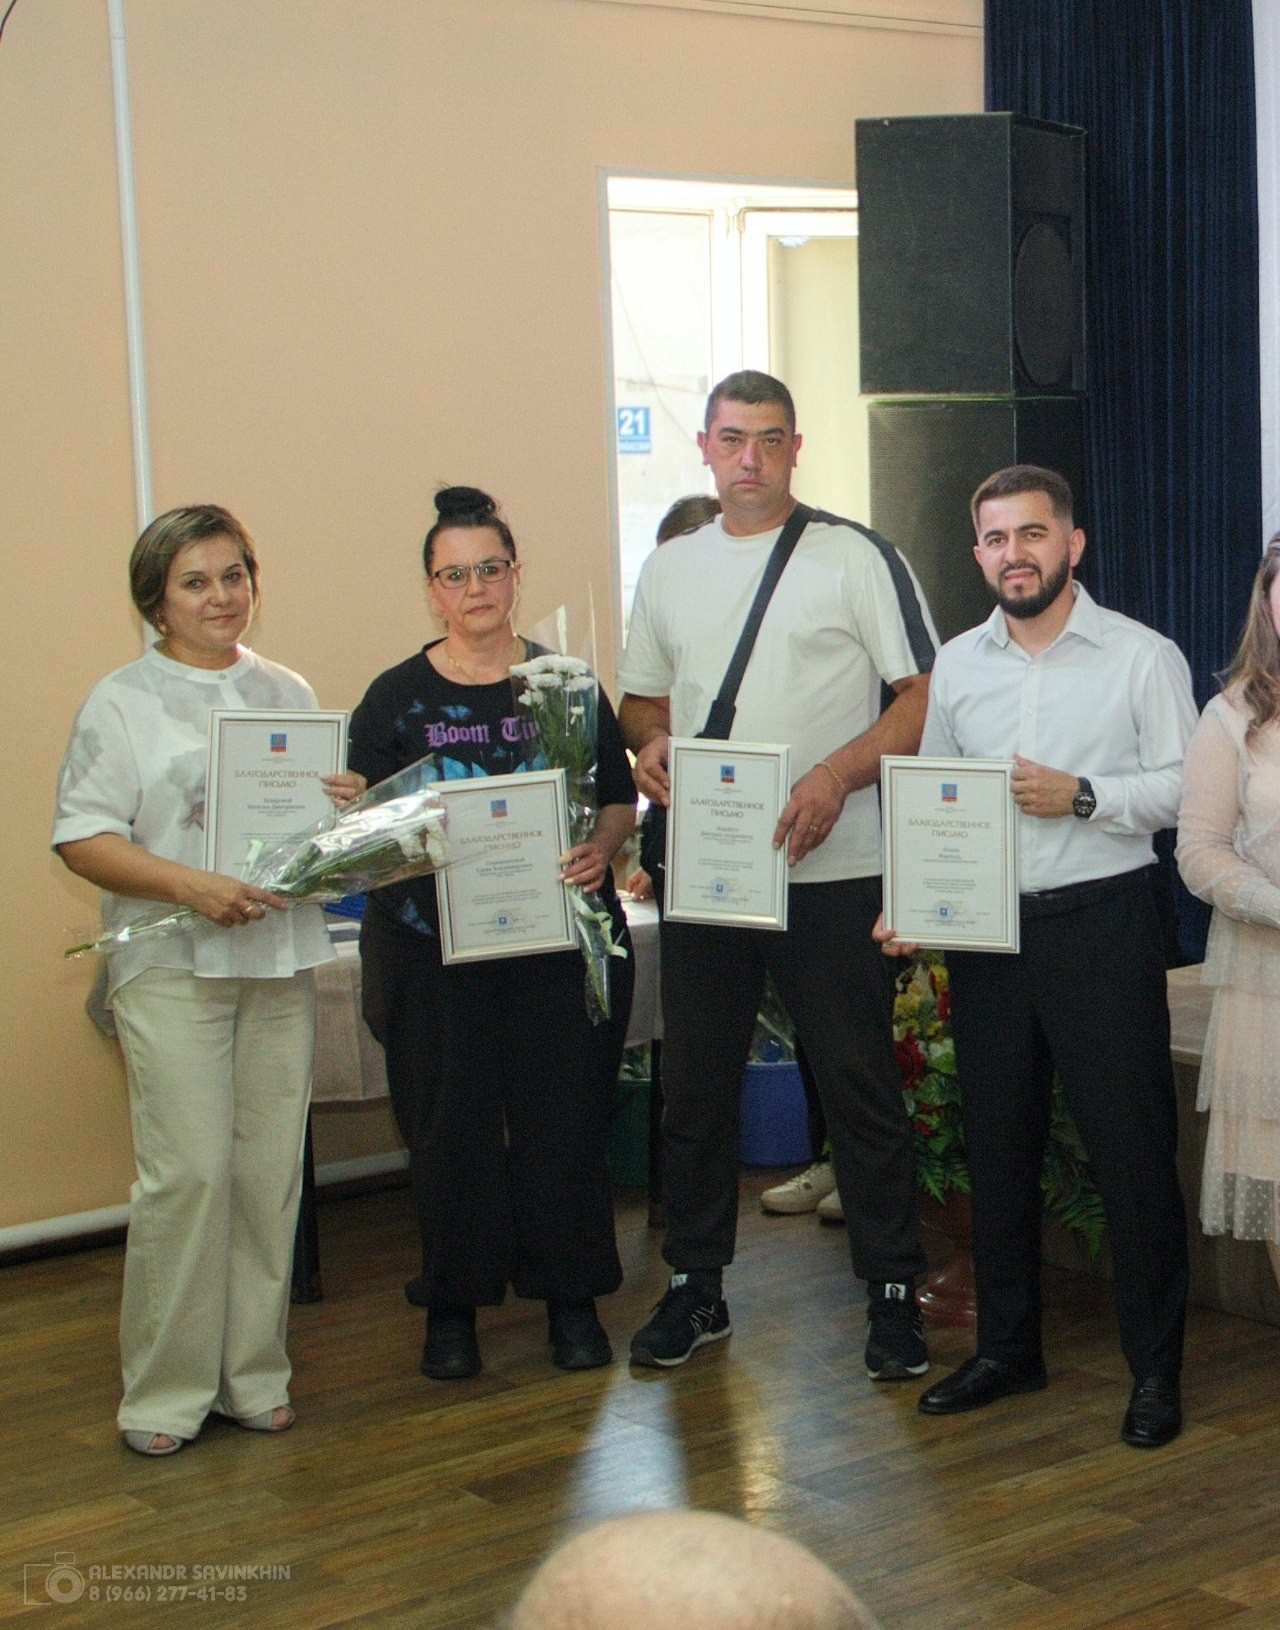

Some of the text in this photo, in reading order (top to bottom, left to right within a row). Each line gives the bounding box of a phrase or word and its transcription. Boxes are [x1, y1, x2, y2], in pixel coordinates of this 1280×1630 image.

[620, 409, 645, 435] 21
[424, 721, 491, 748] Boom
[259, 780, 298, 789] ПИСЬМО
[690, 797, 766, 811] БЛАГОДАРСТВЕННОЕ
[710, 808, 745, 819] ПИСЬМО
[908, 818, 992, 829] БЛАГОДАРСТВЕННОЕ
[931, 829, 969, 839] ПИСЬМО
